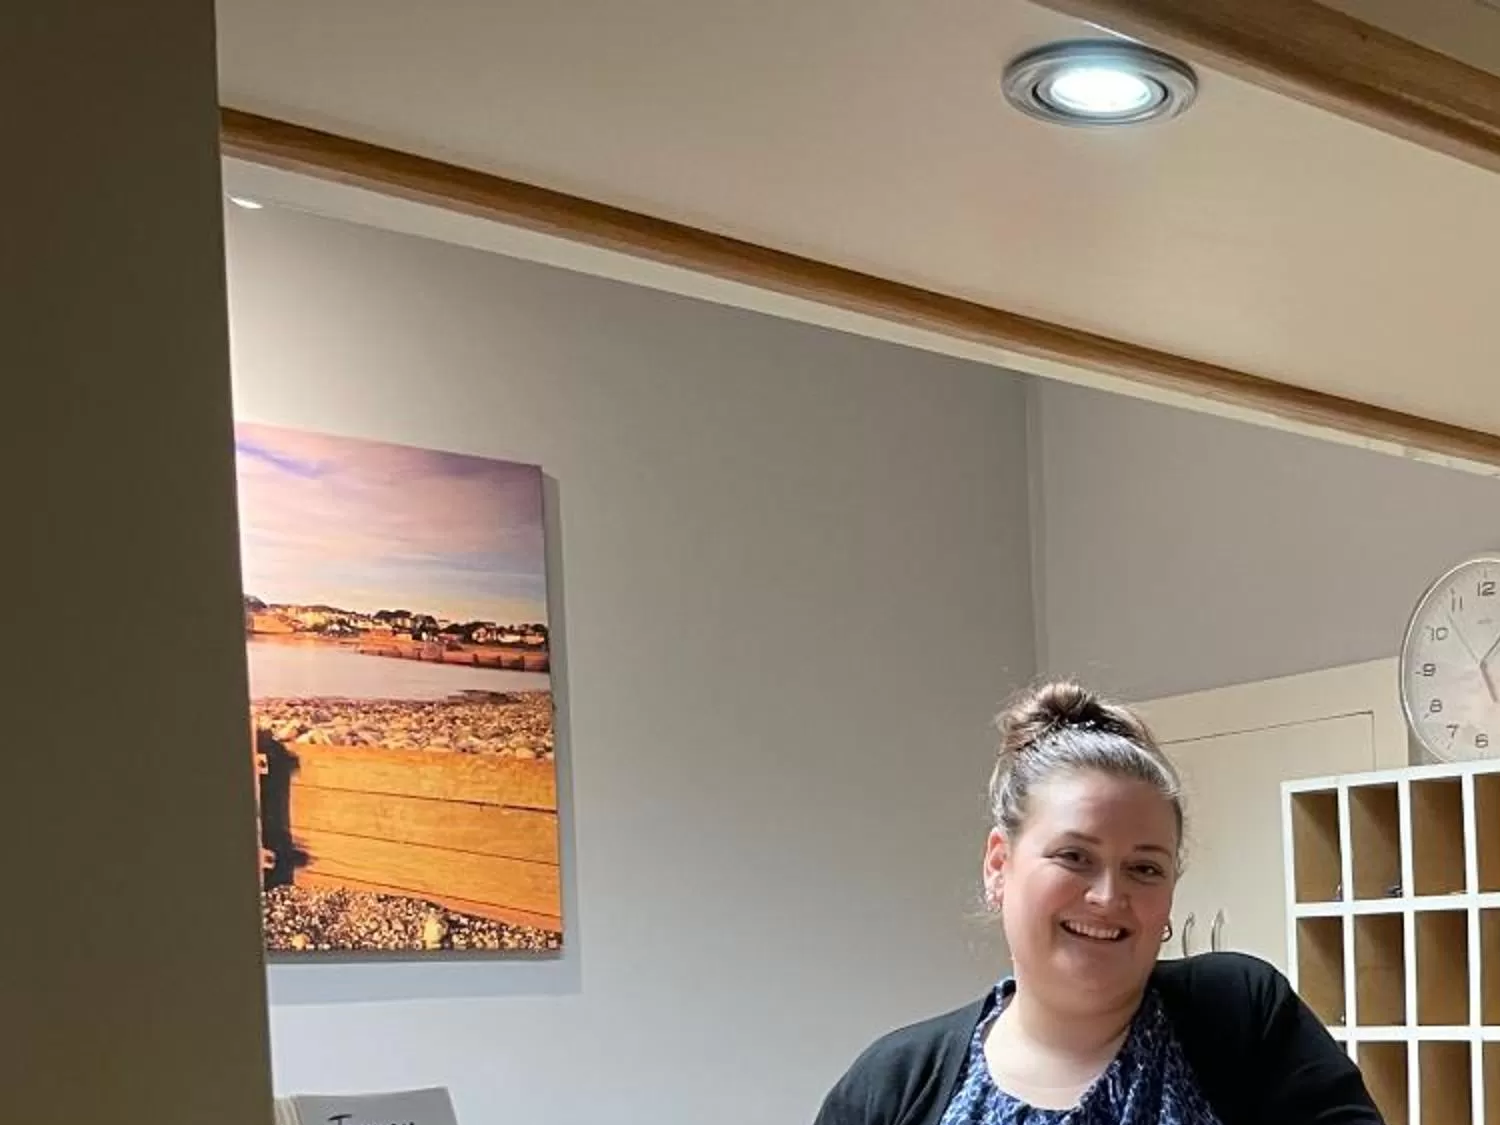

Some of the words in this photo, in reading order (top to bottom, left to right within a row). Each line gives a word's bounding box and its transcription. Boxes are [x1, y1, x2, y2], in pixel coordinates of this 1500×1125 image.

[1476, 581, 1496, 597] 12
[1451, 595, 1464, 613] 11
[1430, 626, 1449, 642] 10
[1422, 663, 1436, 678] 9
[1429, 699, 1443, 714] 8
[1446, 724, 1460, 739] 7
[1474, 733, 1489, 749] 6
